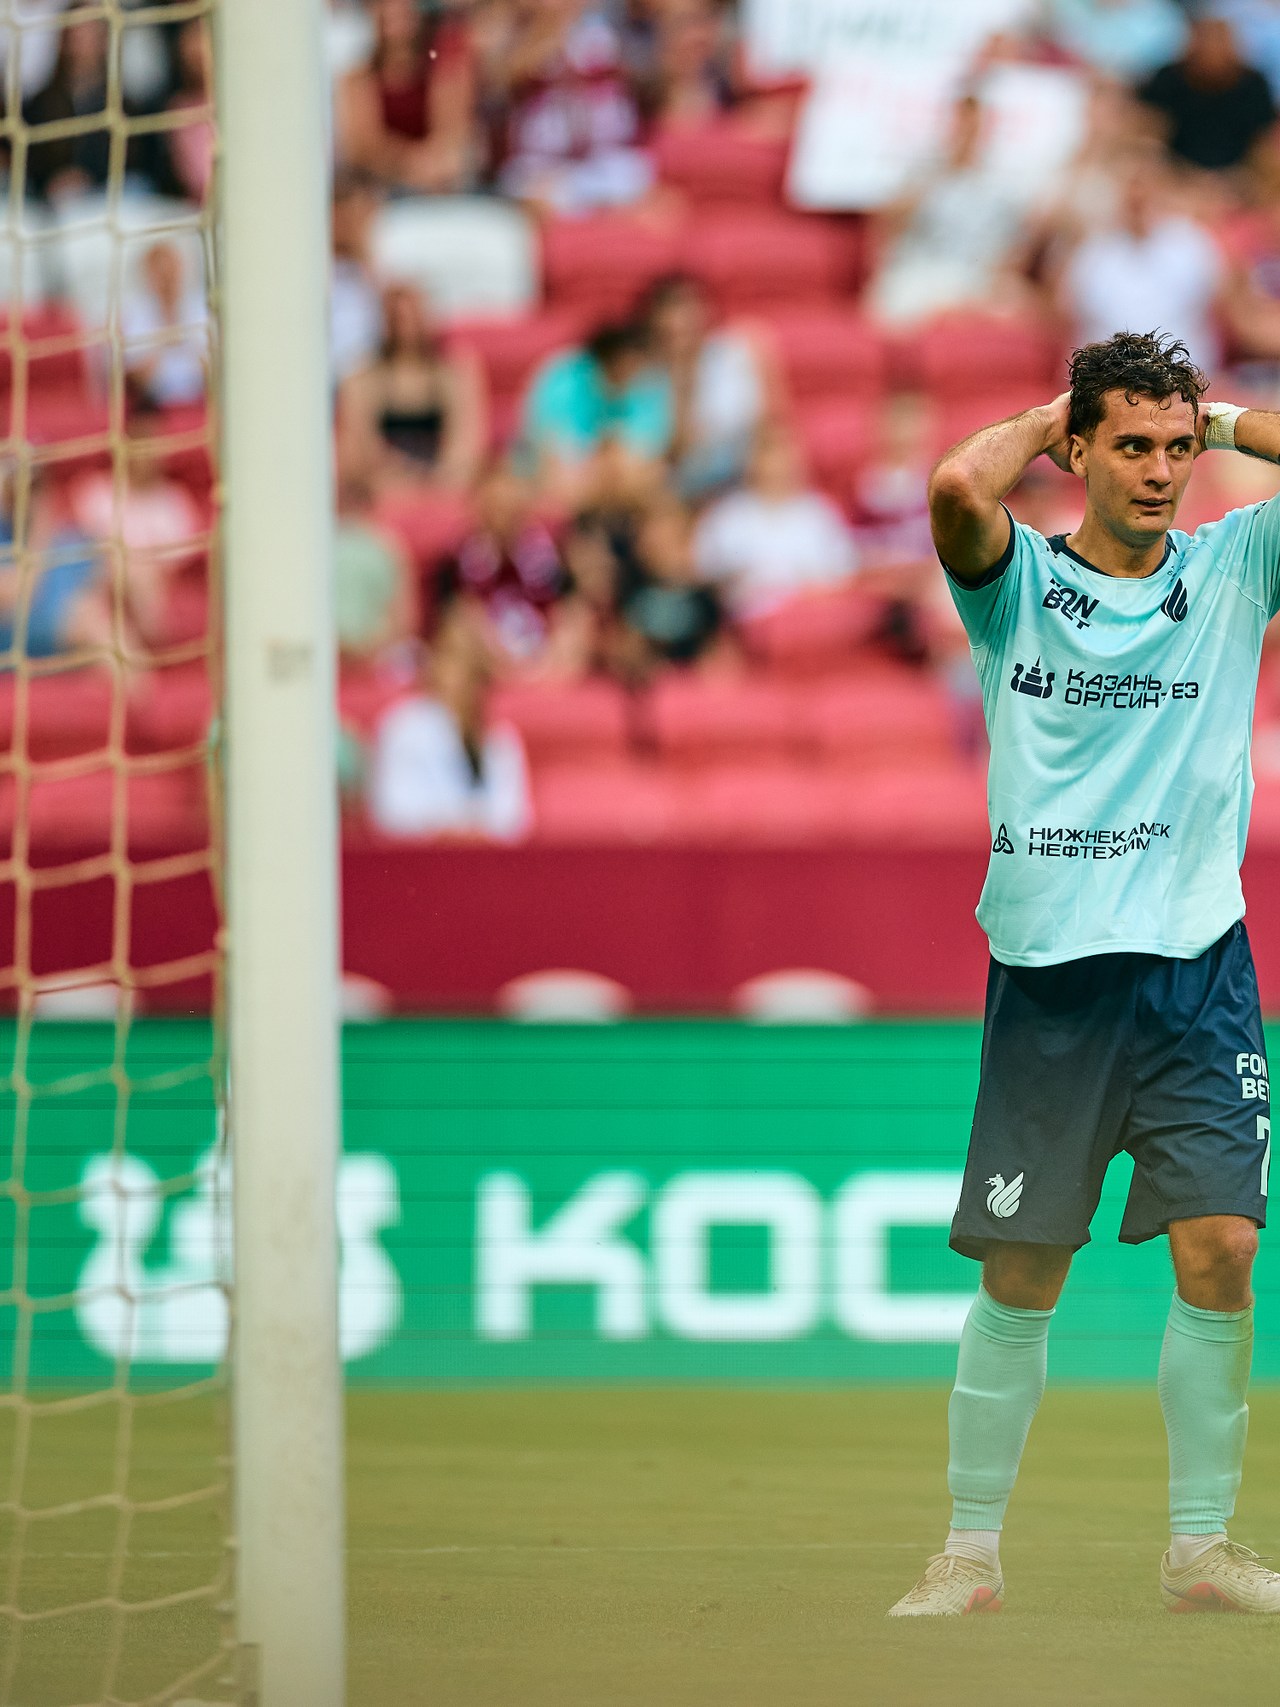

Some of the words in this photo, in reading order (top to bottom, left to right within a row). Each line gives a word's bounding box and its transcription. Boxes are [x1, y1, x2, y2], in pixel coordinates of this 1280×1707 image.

[1050, 578, 1100, 619] ON
[1066, 668, 1162, 692] КАЗАНЬ
[1028, 837, 1151, 860] НЕФТЕХИМ
[476, 1168, 970, 1340] КОС
